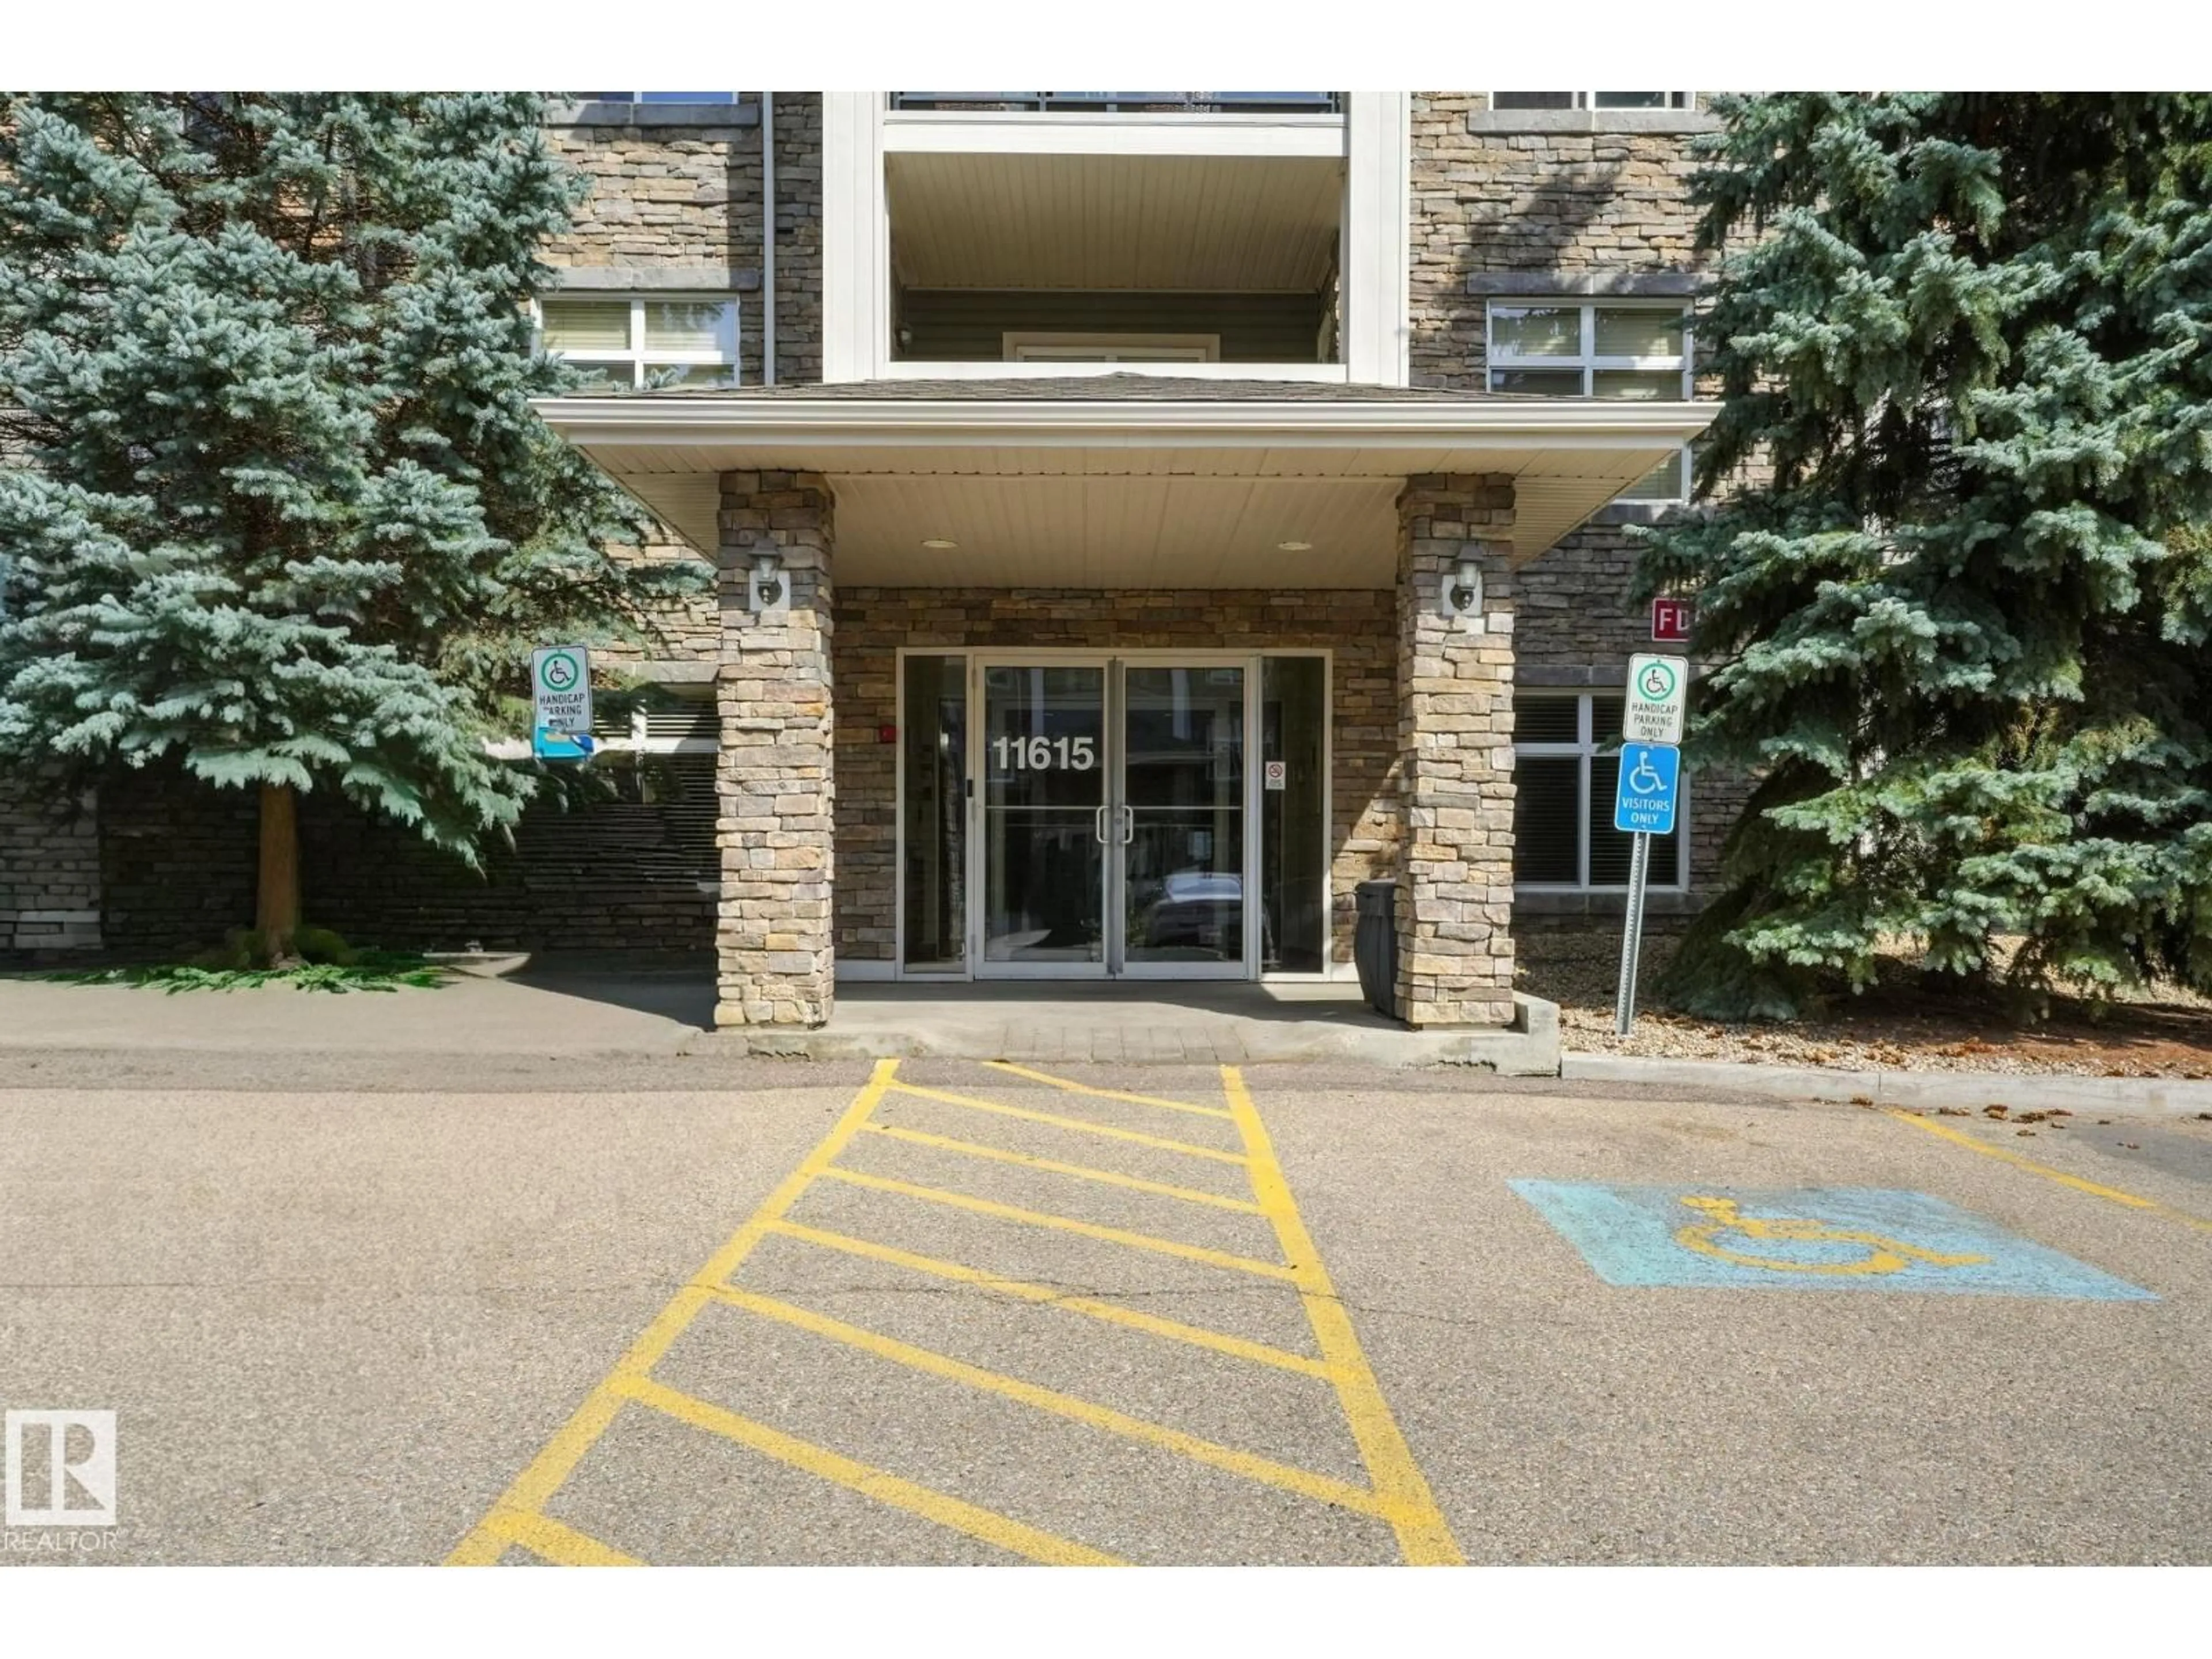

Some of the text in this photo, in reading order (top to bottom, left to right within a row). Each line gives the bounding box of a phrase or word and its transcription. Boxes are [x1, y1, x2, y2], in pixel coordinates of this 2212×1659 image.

[539, 693, 585, 705] HANDICAP
[1631, 702, 1678, 714] HANDICAP
[1634, 714, 1673, 726] PARKING
[1641, 726, 1664, 738] ONLY
[993, 736, 1094, 771] 11615
[1622, 797, 1670, 812] VISITORS
[1631, 812, 1658, 824] ONLY
